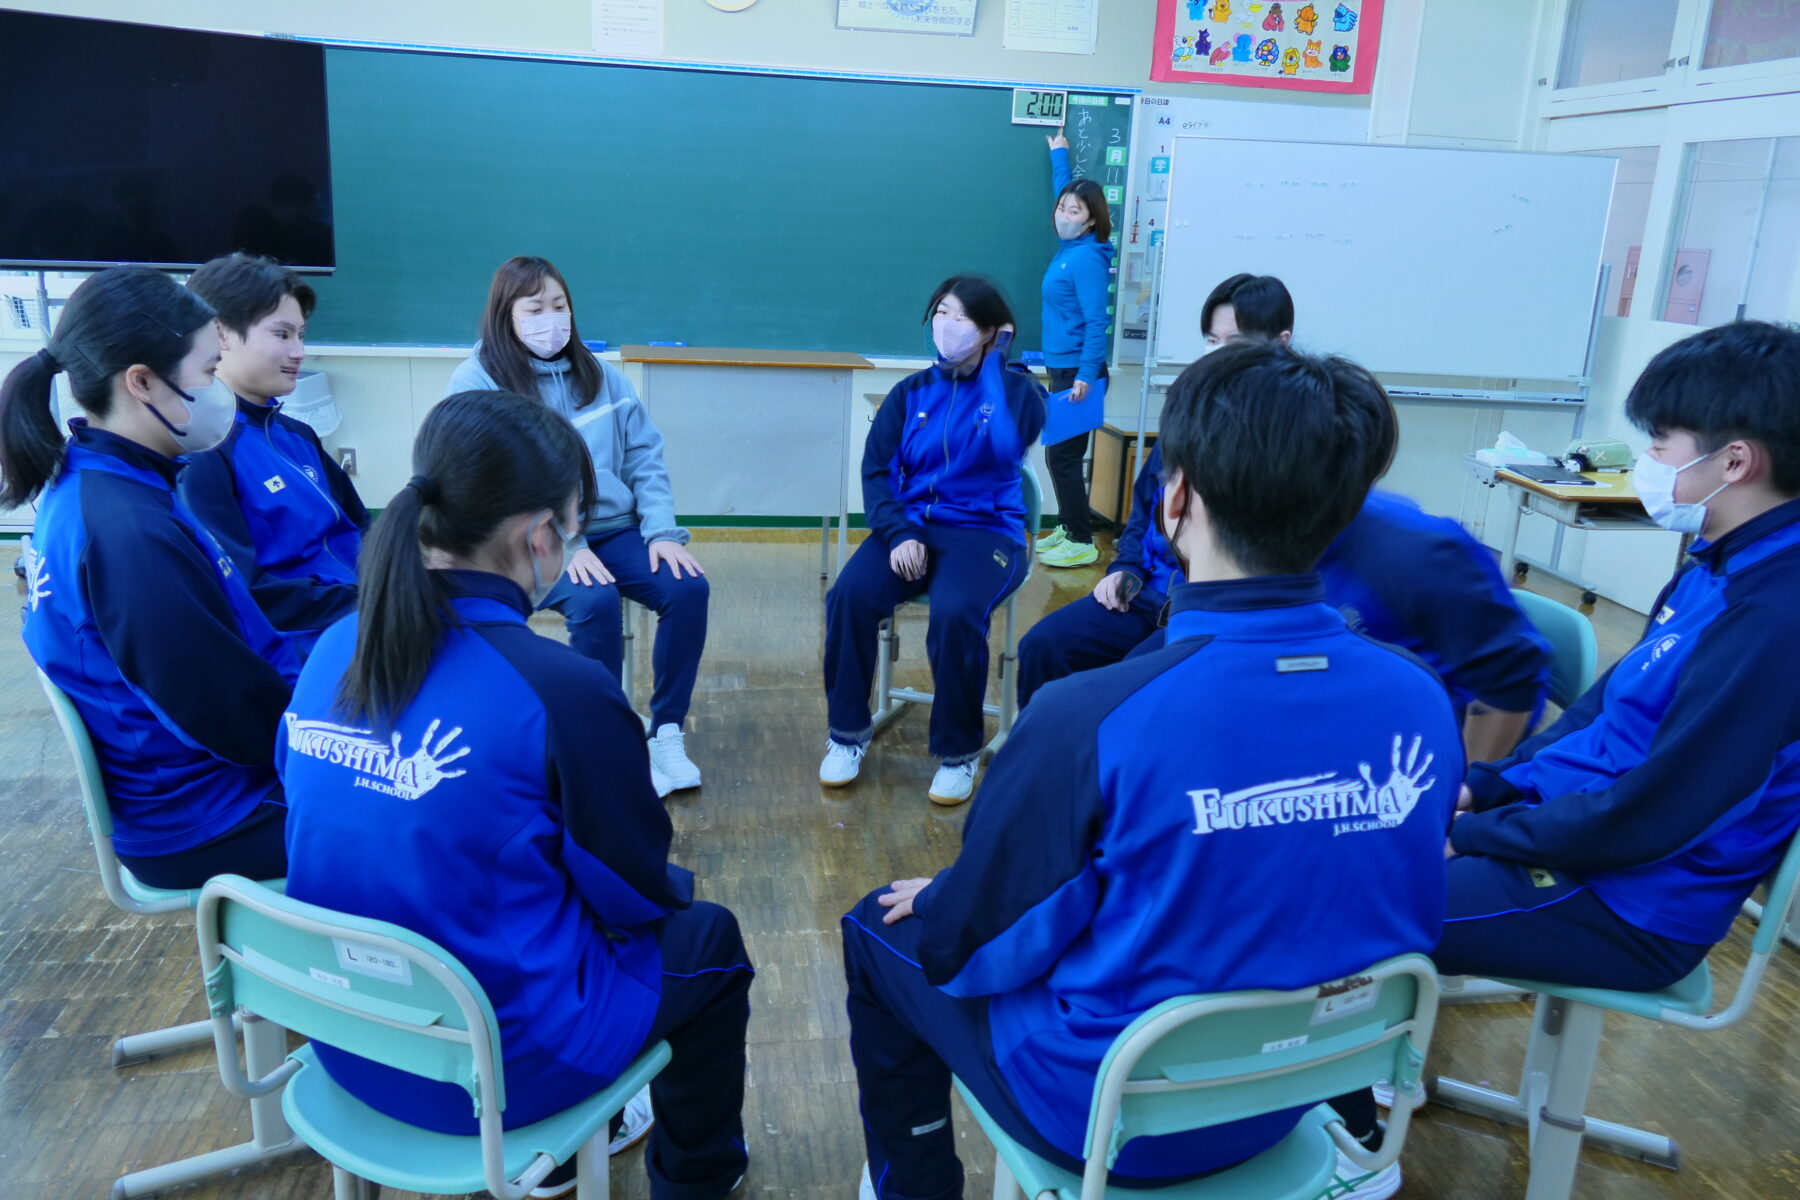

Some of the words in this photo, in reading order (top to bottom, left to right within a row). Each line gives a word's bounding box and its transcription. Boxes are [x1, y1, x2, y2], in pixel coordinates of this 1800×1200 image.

[1026, 91, 1063, 117] 2:00
[1158, 116, 1171, 125] A4
[1187, 786, 1401, 835] FUKUSHIMA
